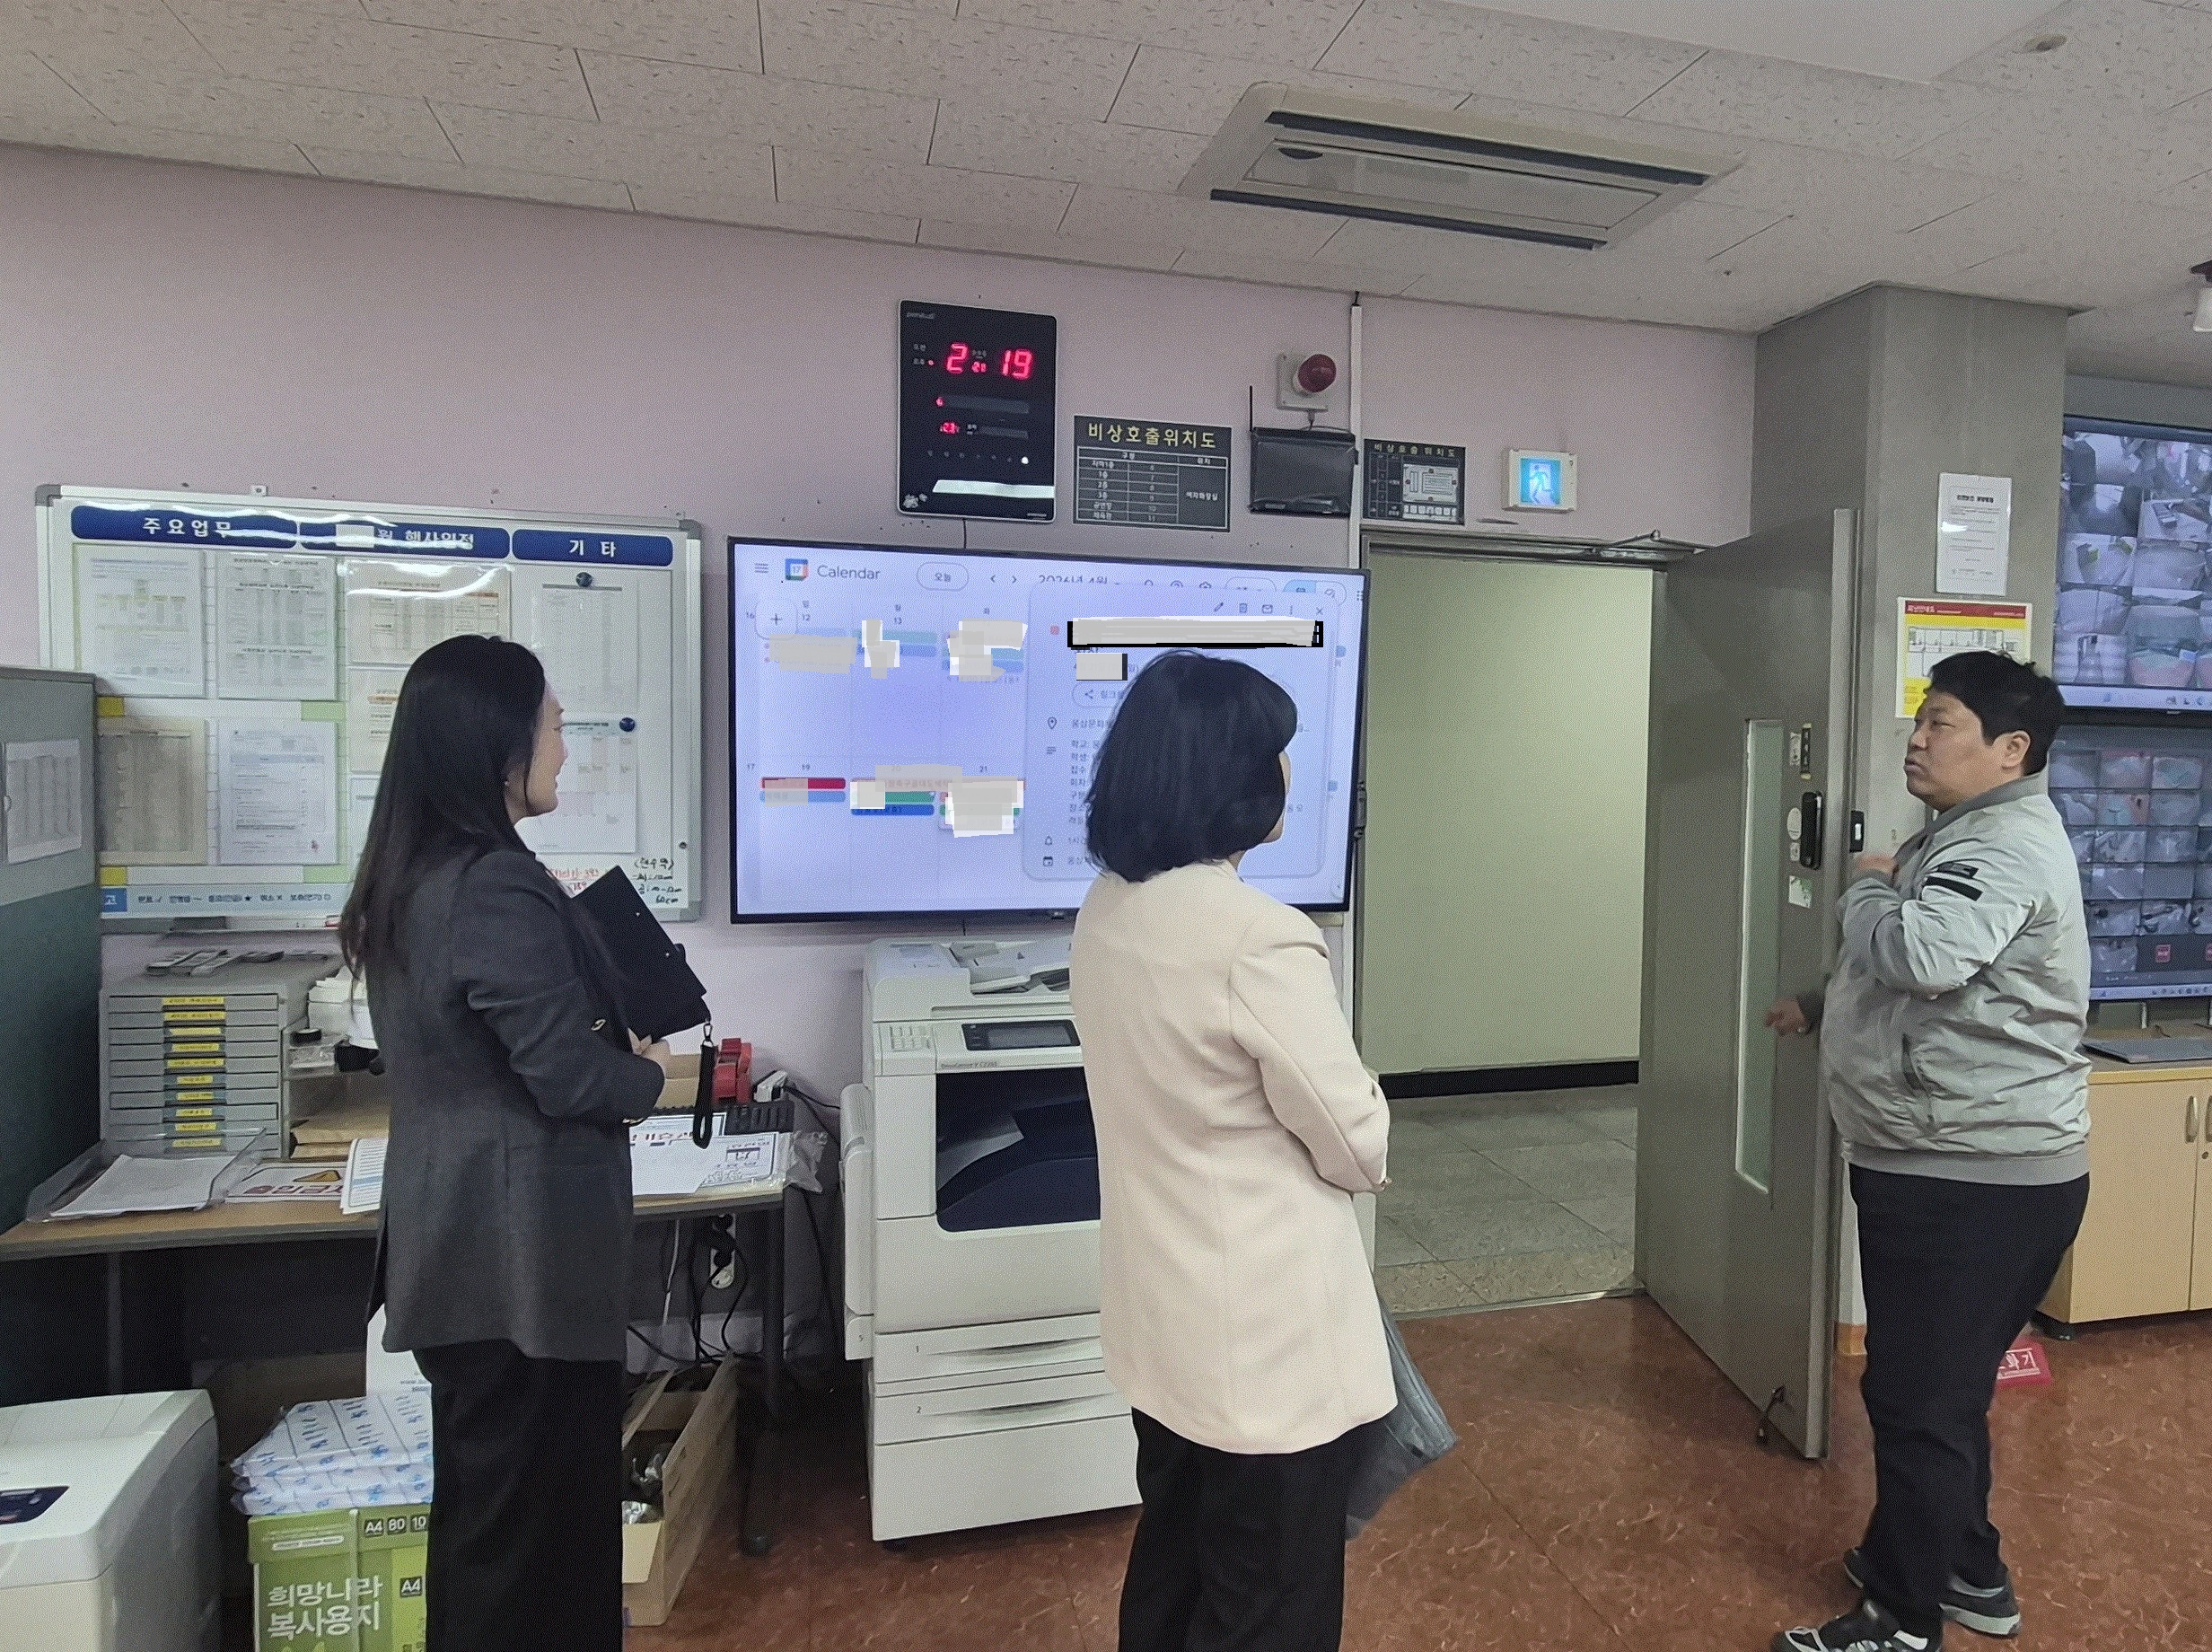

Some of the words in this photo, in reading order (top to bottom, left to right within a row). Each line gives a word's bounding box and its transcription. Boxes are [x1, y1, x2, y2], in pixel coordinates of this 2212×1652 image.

[946, 342, 970, 374] 2
[1002, 348, 1033, 380] 19
[1088, 423, 1216, 449] 비상호출위치도
[143, 517, 231, 539] 주요업무
[817, 565, 881, 580] Calendar
[935, 572, 952, 583] 오늘
[802, 613, 810, 621] 12
[893, 617, 902, 625] 13
[917, 1406, 922, 1414] 2
[364, 1521, 383, 1533] A4
[388, 1517, 405, 1532] 80
[268, 1574, 383, 1608] 희망나라
[400, 1577, 422, 1594] A4
[268, 1600, 380, 1641] 복사용지
